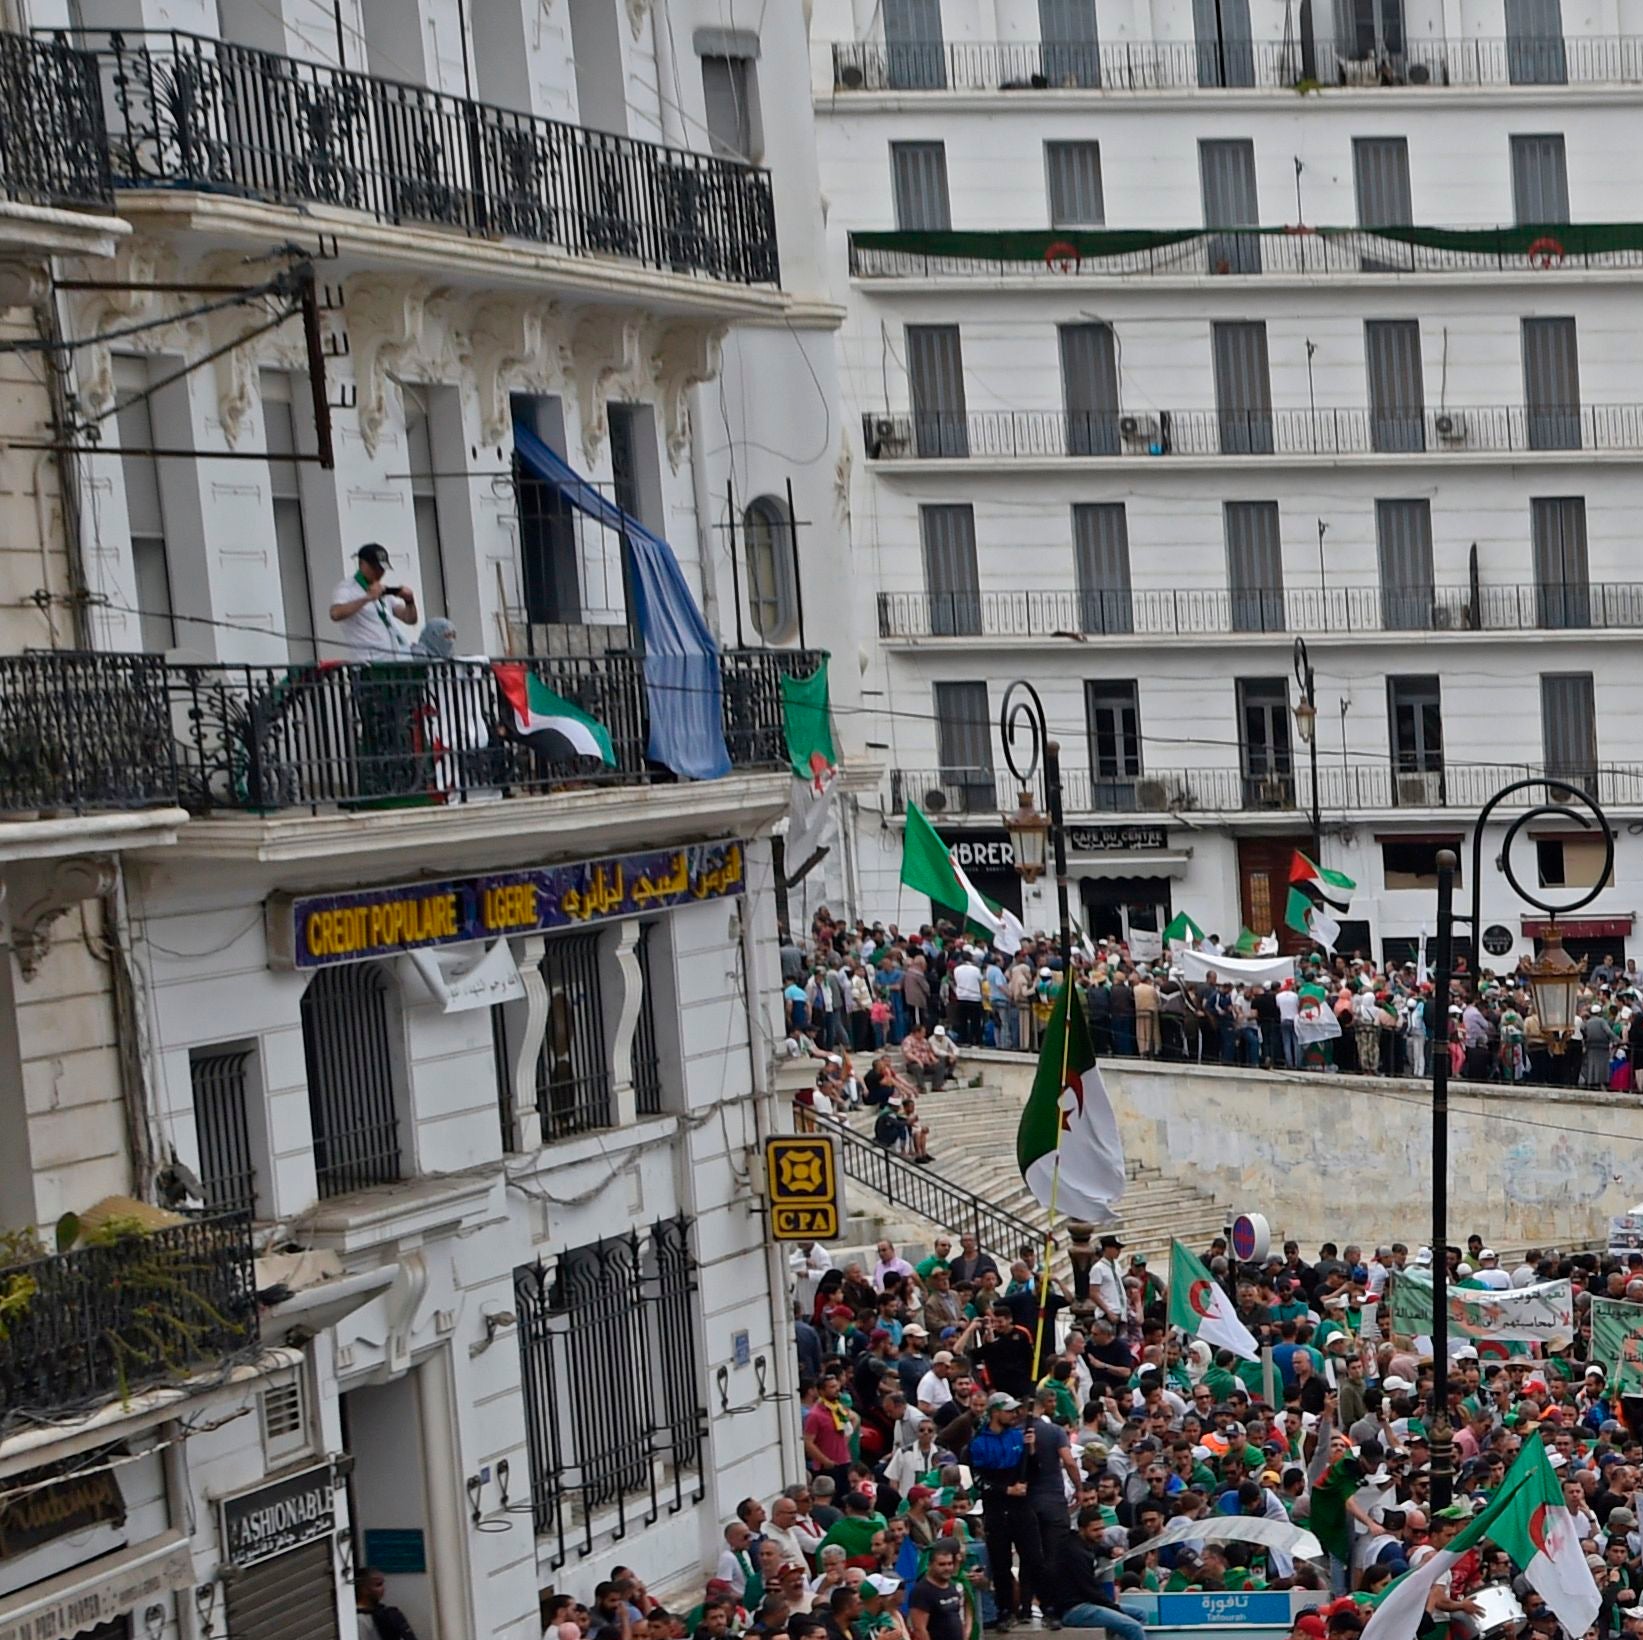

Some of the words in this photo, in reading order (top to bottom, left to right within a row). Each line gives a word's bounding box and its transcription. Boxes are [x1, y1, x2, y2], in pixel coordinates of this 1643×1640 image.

[1121, 830, 1163, 842] CENTRE
[308, 907, 368, 957] CREDIT
[371, 893, 458, 947] POPULAIRE
[779, 1211, 829, 1231] CPA
[231, 1485, 335, 1546] ASHIONABLE
[1202, 1595, 1249, 1613] تافورة
[1207, 1613, 1247, 1622] Tafourah
